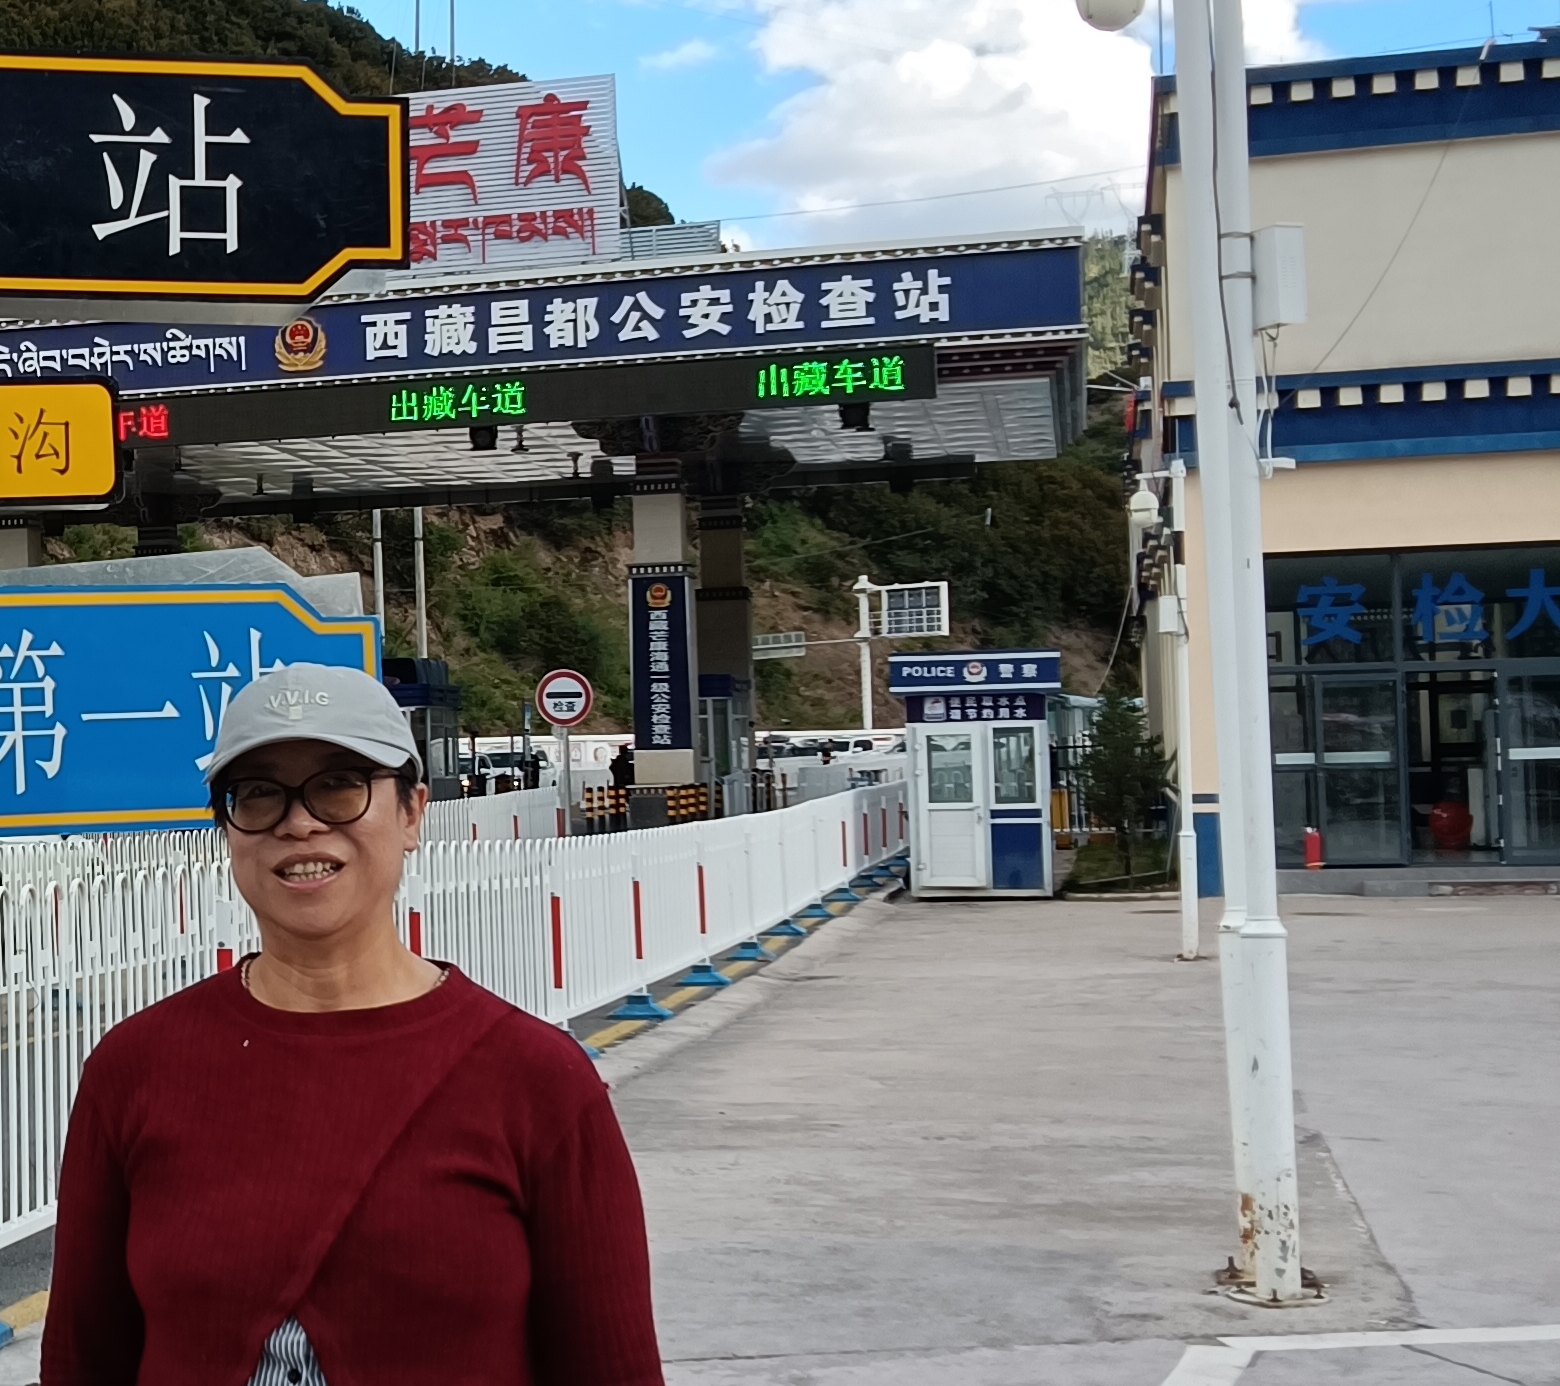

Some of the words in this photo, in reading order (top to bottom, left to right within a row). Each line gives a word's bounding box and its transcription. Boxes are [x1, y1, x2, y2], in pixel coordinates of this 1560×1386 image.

[409, 93, 592, 205] 芒康
[361, 269, 951, 361] 西藏昌都公安检查站
[391, 381, 527, 421] 出藏车道
[902, 666, 955, 677] POLICE
[998, 664, 1038, 678] 警察
[553, 701, 576, 712] 检查
